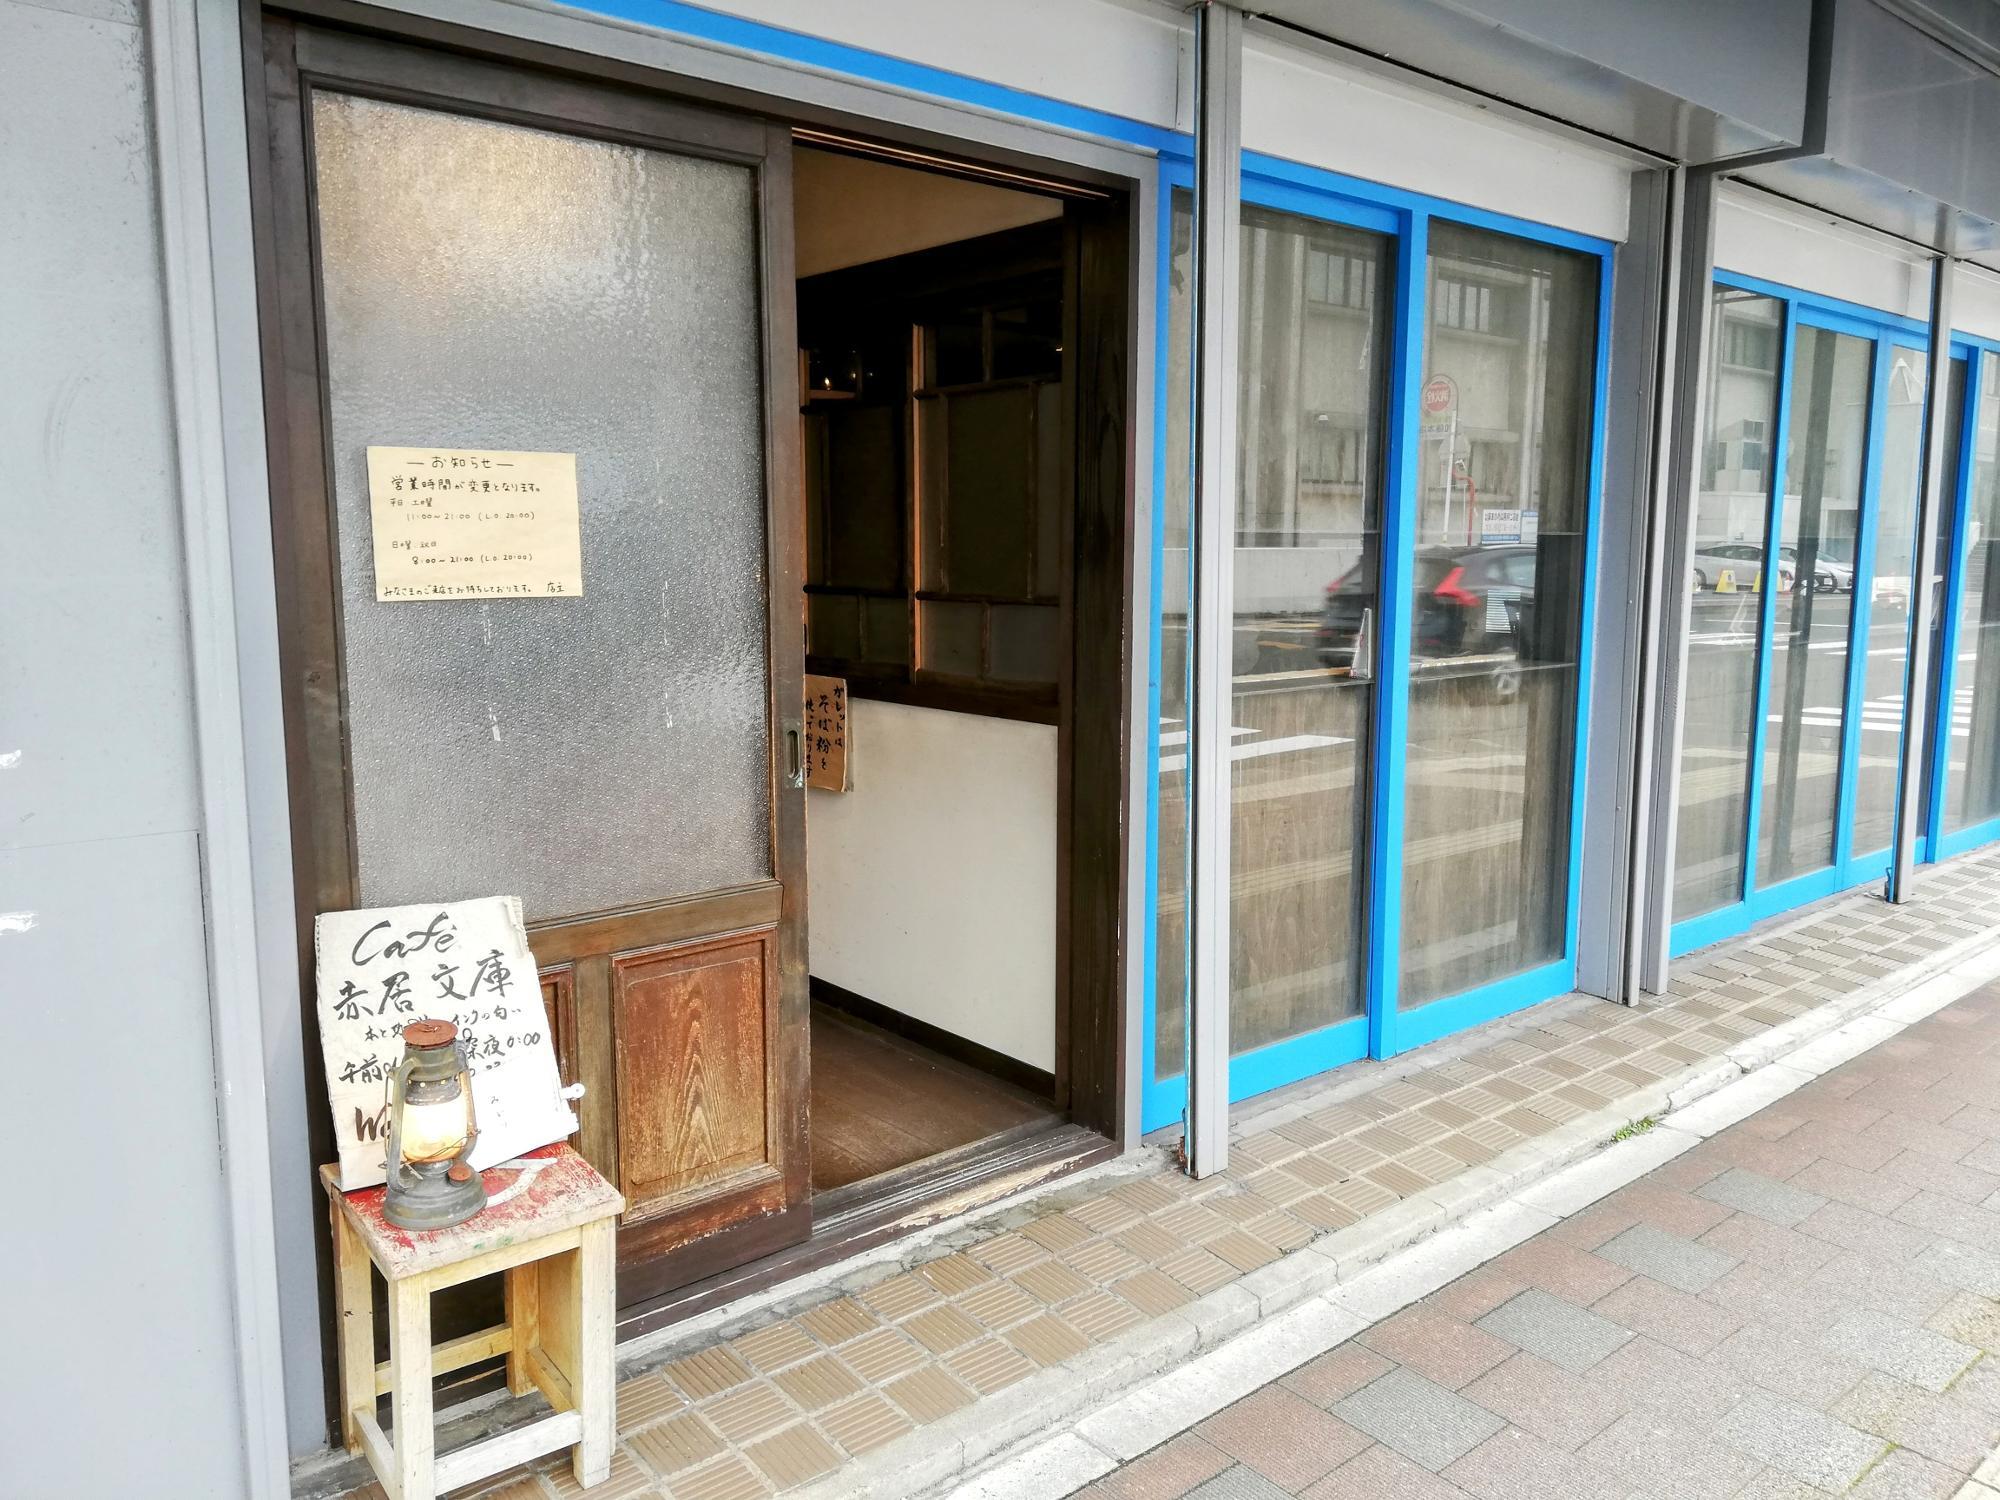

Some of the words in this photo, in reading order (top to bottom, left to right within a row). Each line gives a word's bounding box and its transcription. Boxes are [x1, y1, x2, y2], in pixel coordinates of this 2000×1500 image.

[352, 911, 458, 967] Café
[333, 949, 515, 1021] 赤居文庫
